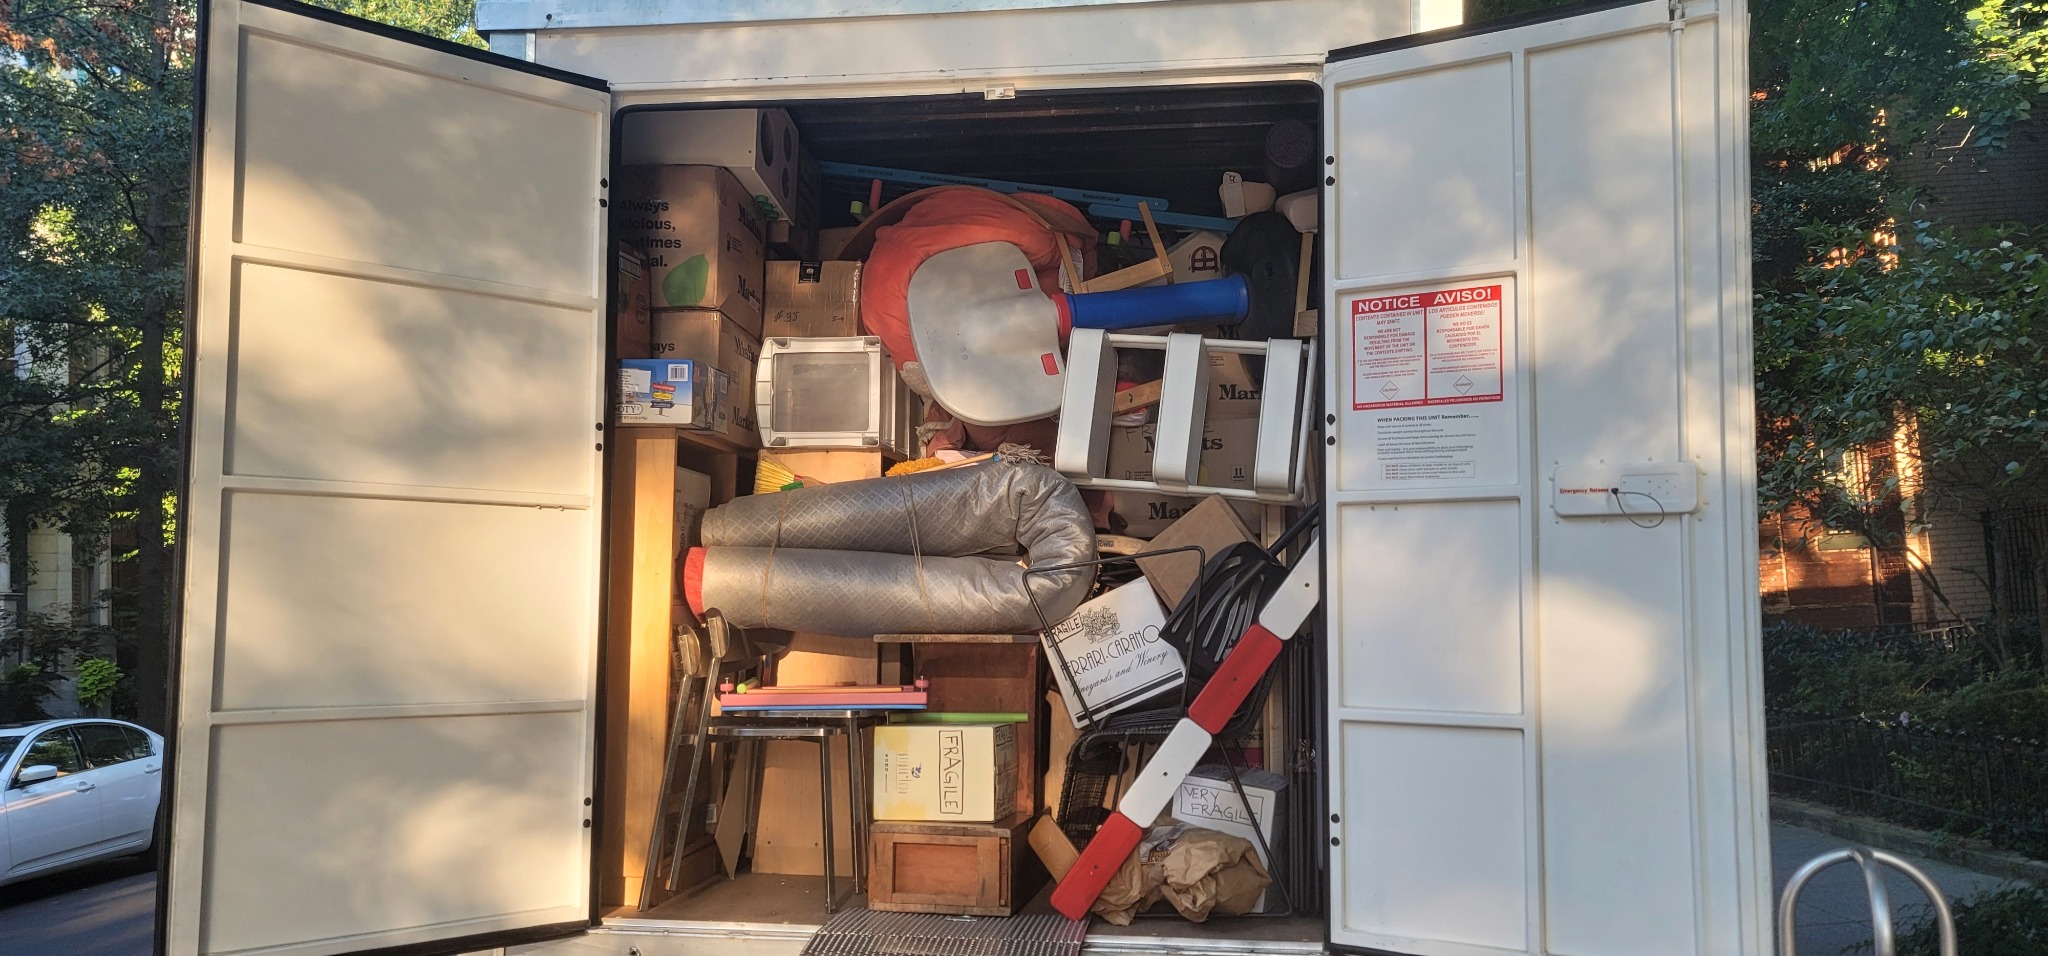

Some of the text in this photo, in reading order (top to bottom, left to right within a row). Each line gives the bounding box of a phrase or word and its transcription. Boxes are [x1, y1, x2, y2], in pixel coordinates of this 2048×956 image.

[1358, 296, 1421, 313] NOTICE
[1433, 288, 1491, 305] AVISO!
[1115, 659, 1134, 678] and
[1135, 648, 1169, 670] Winery
[943, 735, 962, 809] FRAGILE
[1184, 786, 1220, 806] VERY
